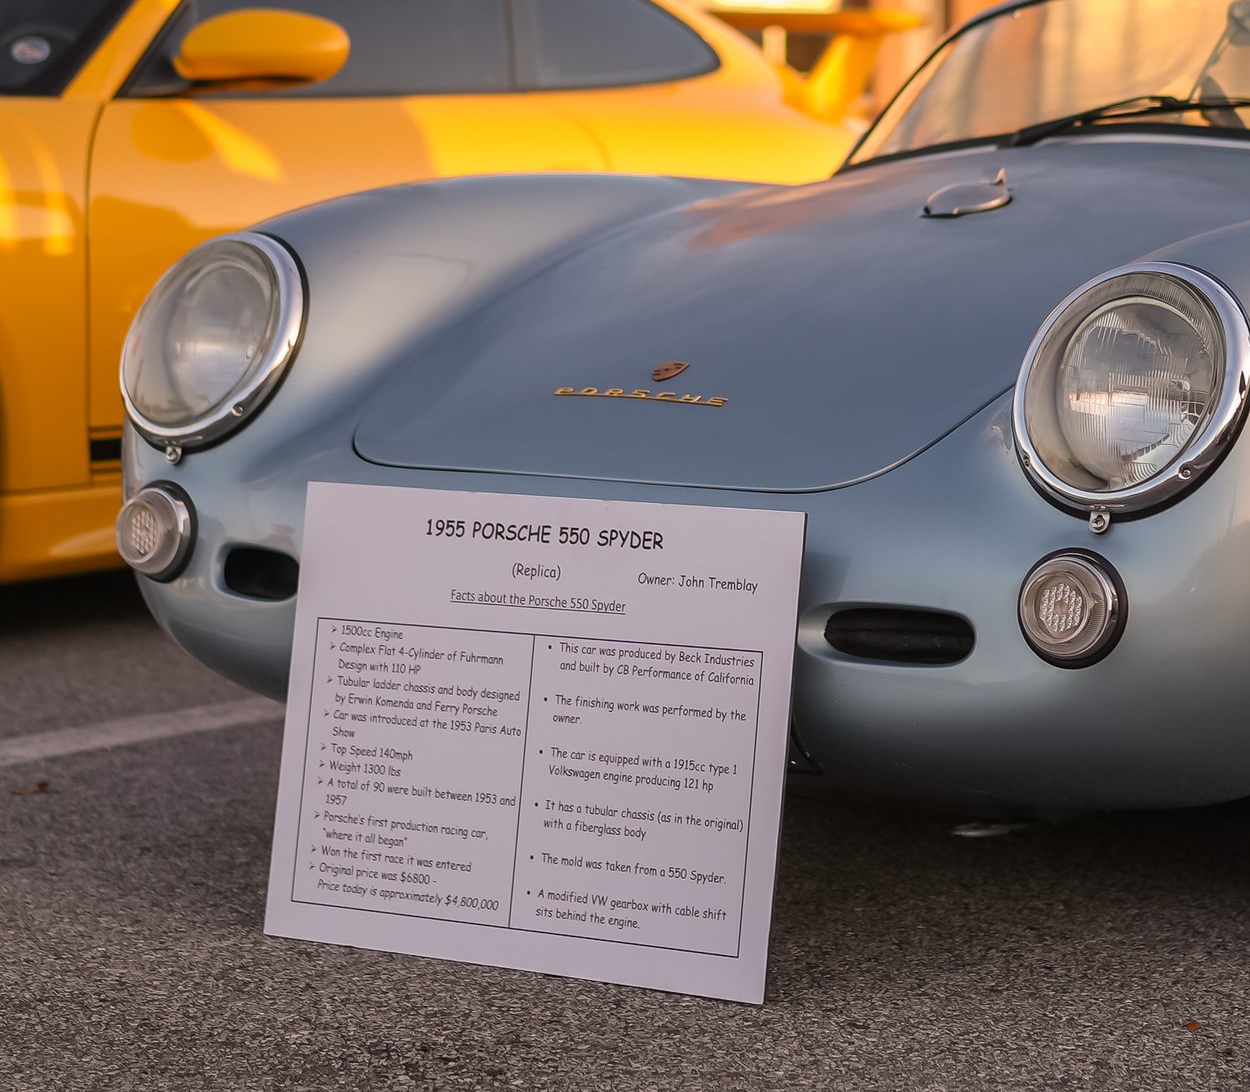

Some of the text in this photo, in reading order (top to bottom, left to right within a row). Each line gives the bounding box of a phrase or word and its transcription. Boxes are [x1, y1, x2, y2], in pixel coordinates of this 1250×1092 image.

[554, 387, 728, 406] PORSCHE
[426, 518, 664, 550] 1955 PORSCHE 550 SPYDER
[512, 562, 561, 582] (Replica)
[637, 572, 759, 595] Owner: John Tremblay
[450, 589, 627, 614] Facts about the Porsche 550 Spyder
[341, 625, 404, 642] 1500cc Engine
[339, 642, 504, 665] Complex Flat 4-Cylinder of Fuhrmann
[559, 641, 755, 668] This car was produced by Beck Industries
[338, 658, 422, 675] Design with 110 HP
[560, 660, 754, 686] and built by CB Performance of California
[337, 675, 521, 703] Tubular ladder chassis and body designed
[335, 692, 498, 717] by Erwin Komenda and Ferry Porsche
[555, 694, 747, 723] The finishing work was performed by the
[331, 726, 356, 738] Show
[333, 709, 522, 737] Car was introduced the 1953 Paris Auto
[552, 714, 582, 725] owner.
[331, 742, 414, 763] Top Speed 140mph
[550, 746, 730, 777] The car equipped with 1915cc type
[329, 760, 402, 777] Weight 1300 lbs
[549, 764, 714, 794] Volkswagen engine producing 121 hp
[325, 794, 348, 806] 1957
[337, 779, 517, 807] total of 90 were built between 1953 and
[323, 810, 365, 826] Porsche's
[367, 815, 389, 828] first
[390, 820, 439, 834] production
[440, 825, 469, 840] racing
[545, 799, 744, 833] It has tubular chassis (as the original)
[364, 833, 376, 844] all
[543, 818, 647, 842] with fiberglass body
[321, 845, 472, 873] Won the first race was entered
[541, 852, 727, 885] The mold was taken from 550 Spyder.
[319, 862, 431, 885] Original price was $6800
[317, 878, 500, 911] Price today approximately $4,800,000
[547, 890, 727, 922] modified VW gearbox with cable shift
[535, 906, 640, 930] sits behind the engine.
